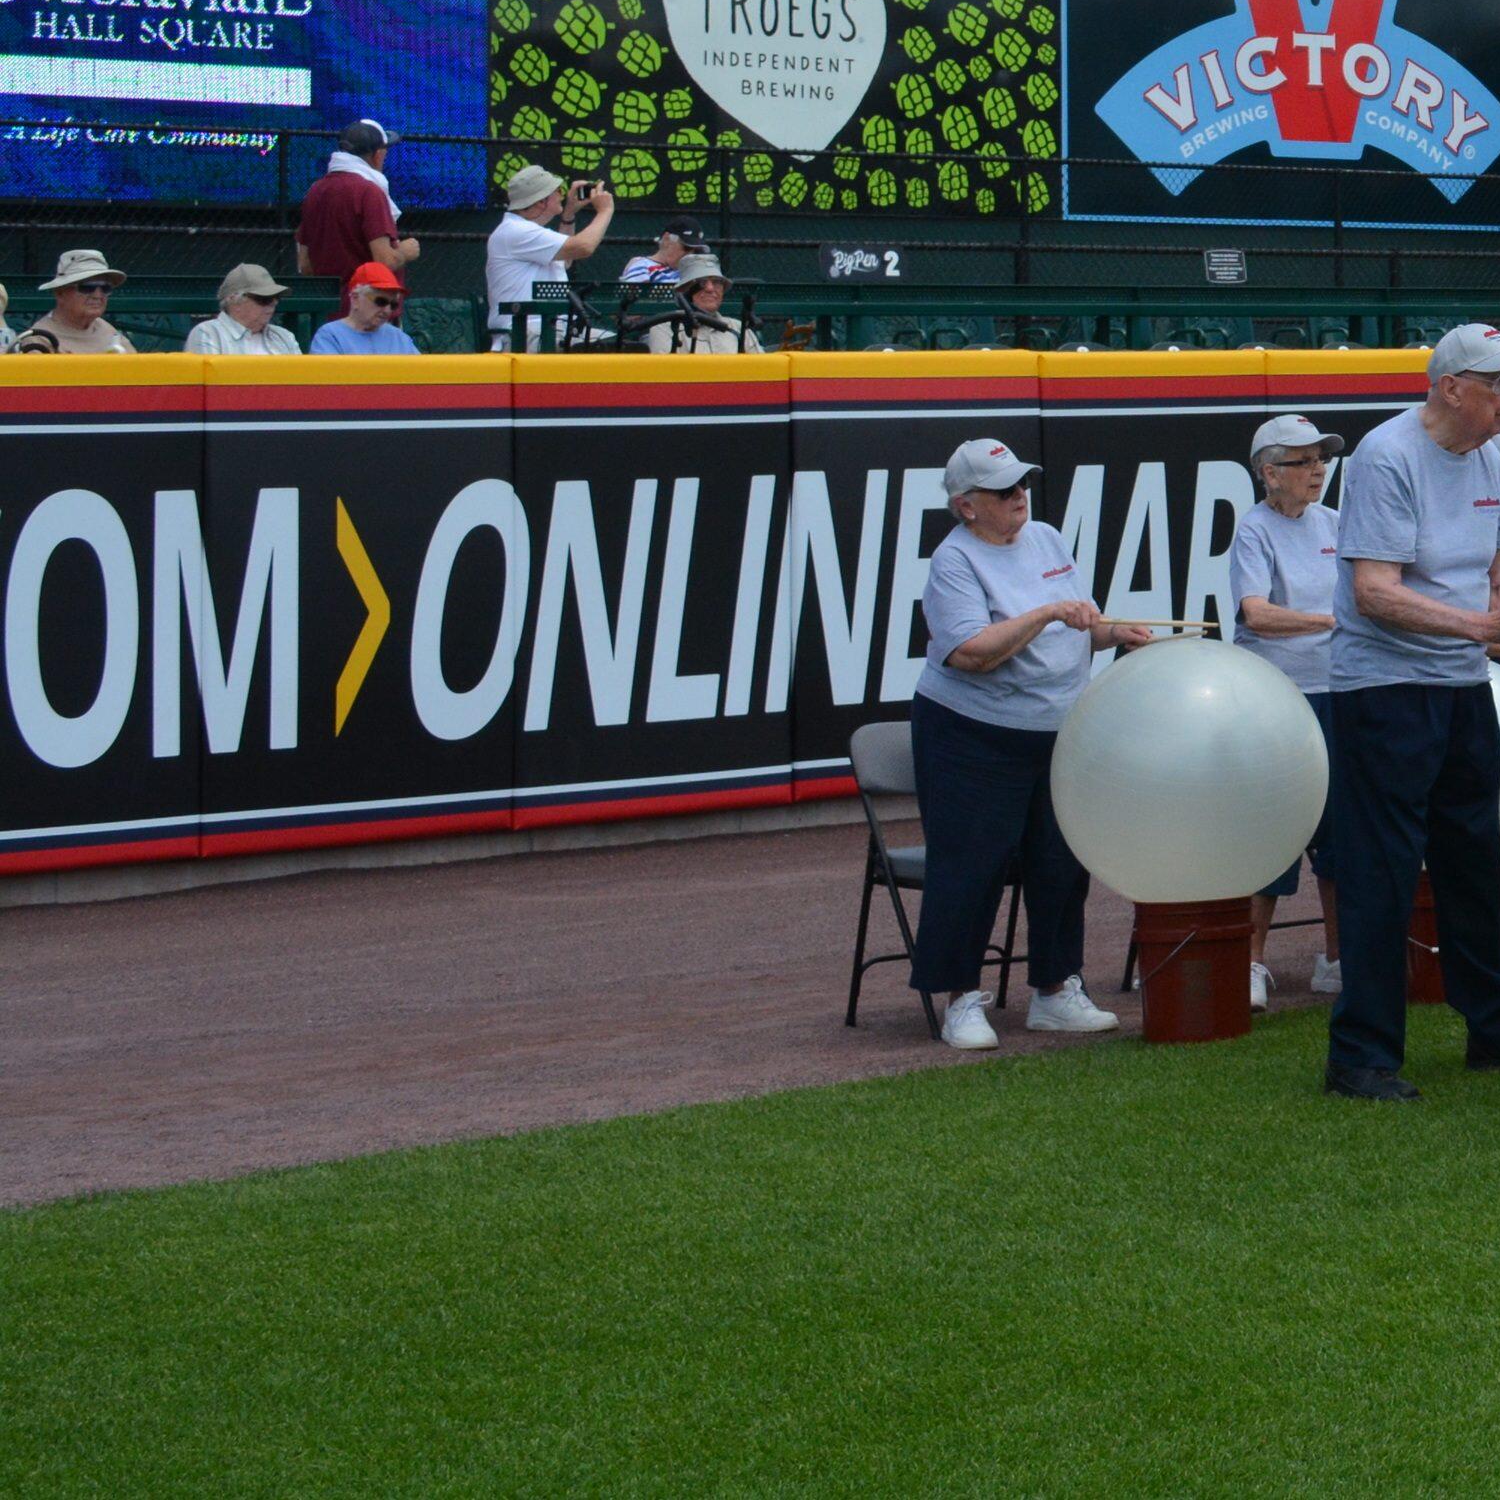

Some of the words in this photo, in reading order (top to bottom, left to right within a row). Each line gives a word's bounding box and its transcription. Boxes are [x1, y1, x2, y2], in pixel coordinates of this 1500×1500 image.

[33, 11, 124, 42] HALL
[139, 17, 275, 51] SQUARE
[703, 50, 855, 74] INDEPENDENT
[741, 79, 835, 101] BREWING
[1144, 30, 1490, 156] VICTORY
[1179, 104, 1269, 159] BREWING
[1364, 110, 1454, 171] COMPANY
[884, 250, 900, 277] 2
[5, 487, 299, 769] OM
[410, 465, 948, 741] ONLINE
